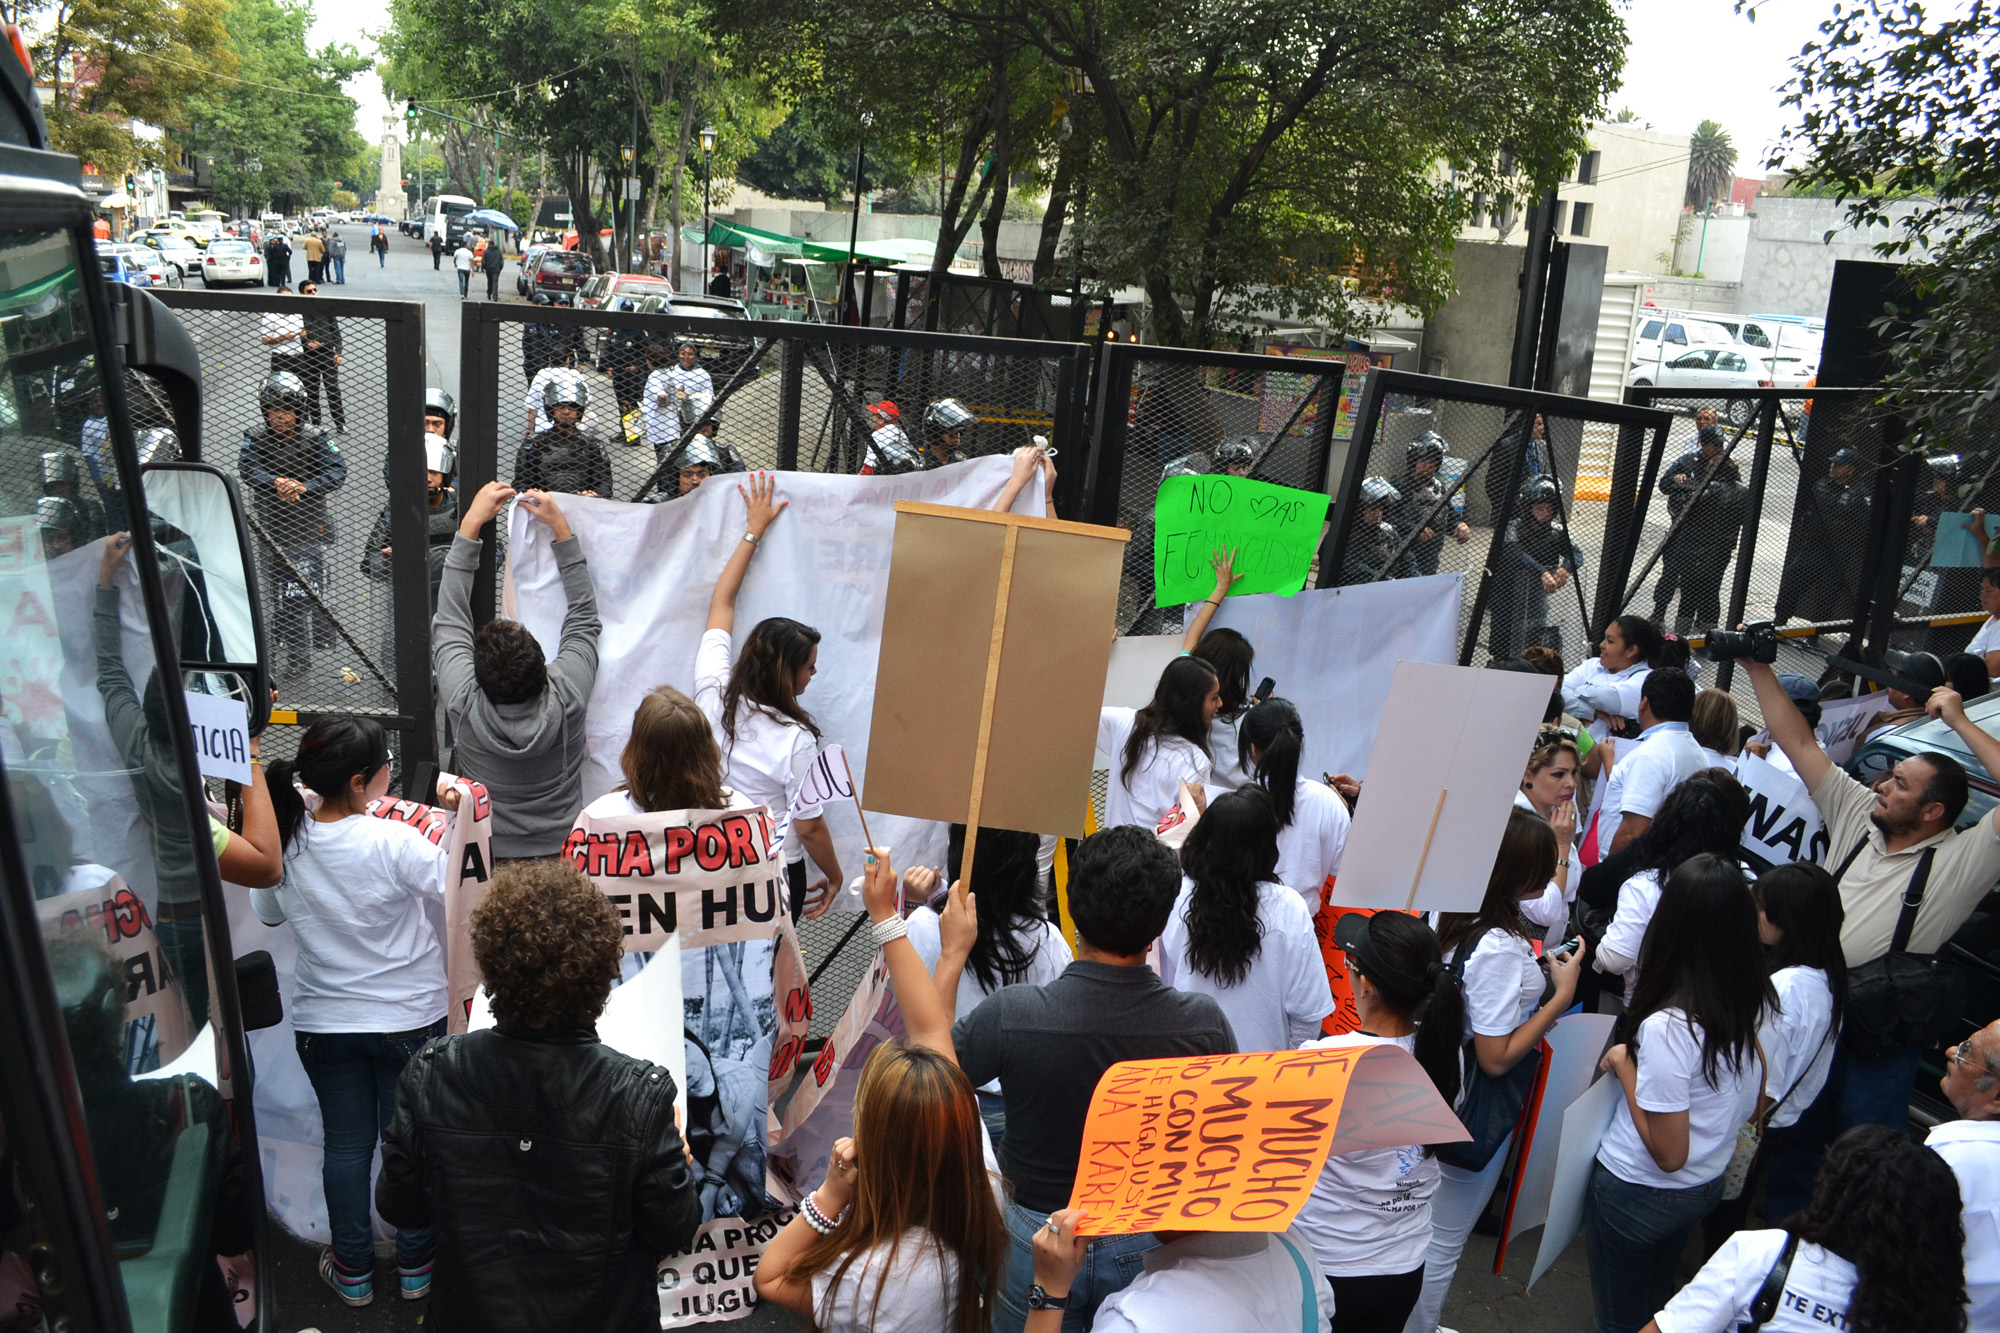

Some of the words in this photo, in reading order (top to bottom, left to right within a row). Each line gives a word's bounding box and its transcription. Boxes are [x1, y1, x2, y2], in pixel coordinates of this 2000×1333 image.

[1000, 260, 1030, 282] TACOS
[1190, 479, 1233, 515] NO
[664, 814, 760, 875] POR
[1097, 1066, 1155, 1119] ANA
[1163, 1089, 1199, 1153] CON
[1180, 1076, 1258, 1219] MUCHO
[1230, 1098, 1334, 1222] MUCHO
[1784, 1289, 1809, 1314] TE
